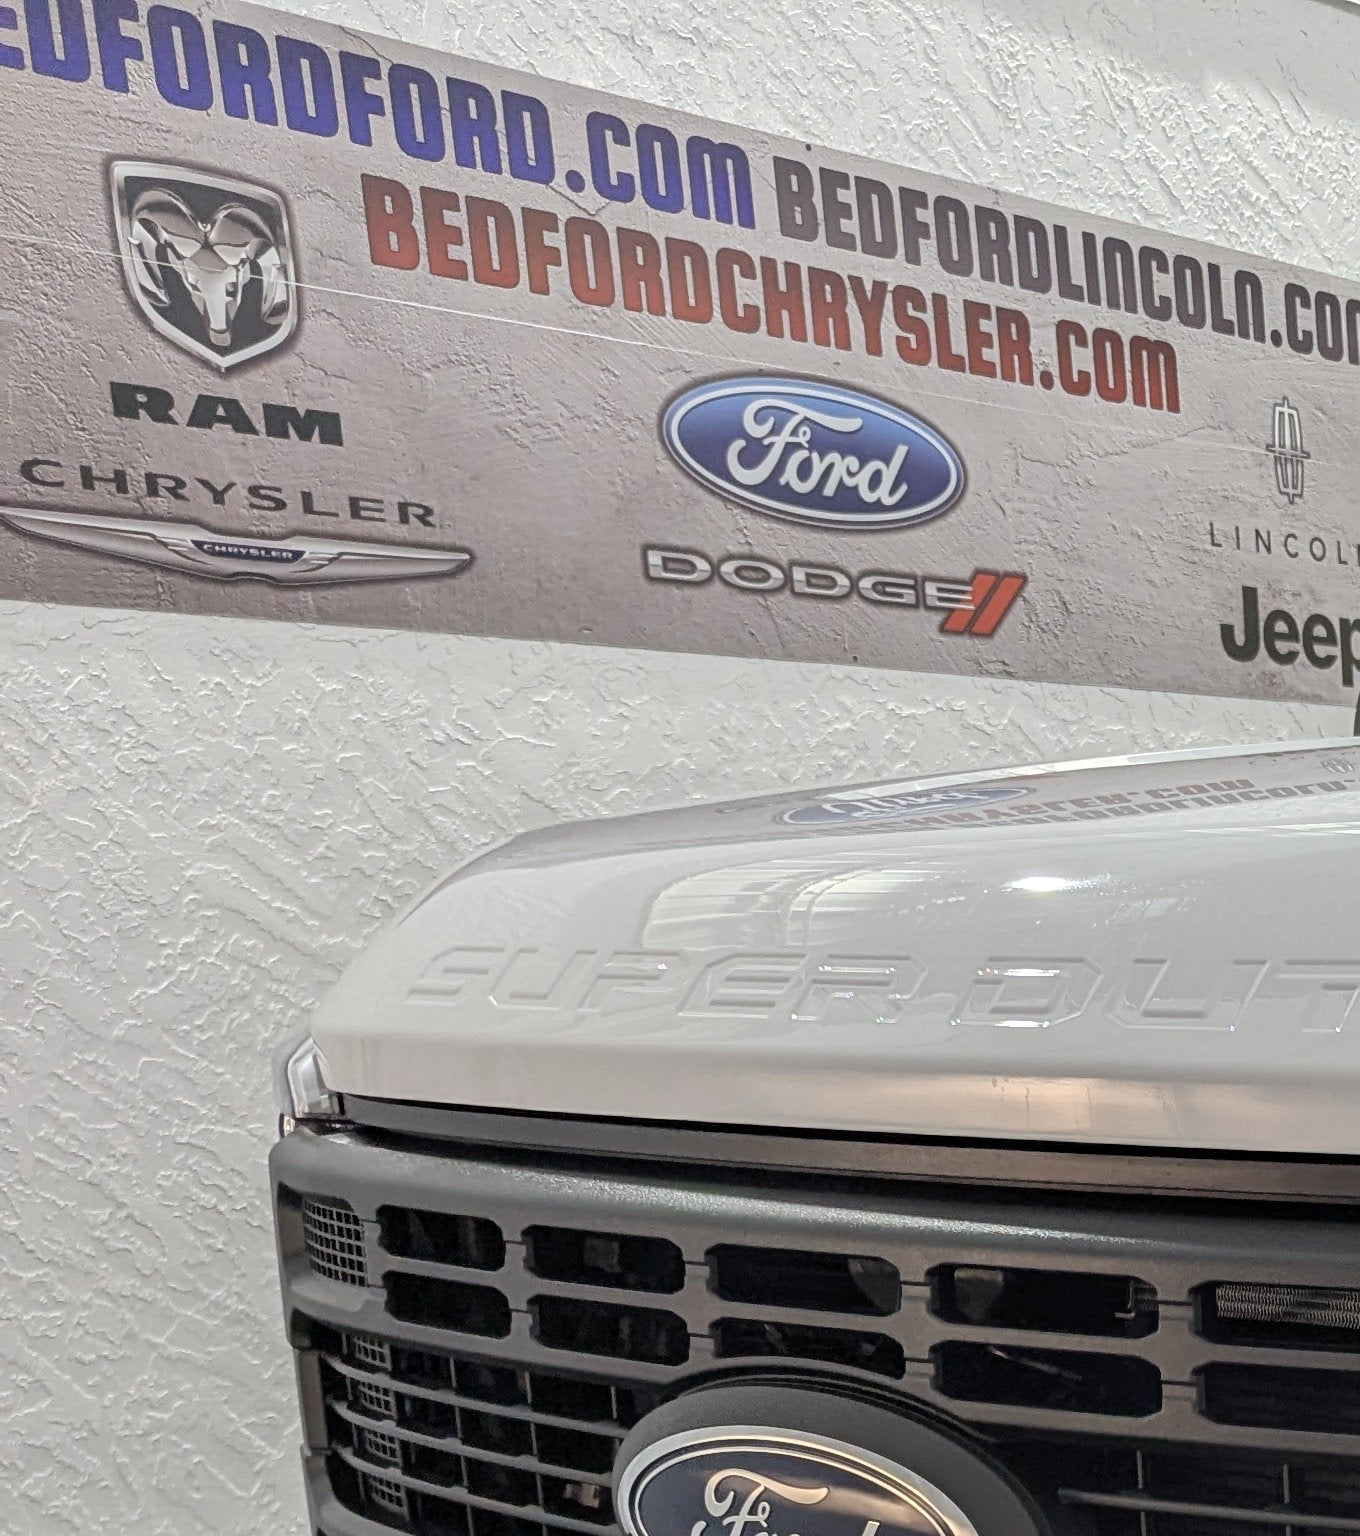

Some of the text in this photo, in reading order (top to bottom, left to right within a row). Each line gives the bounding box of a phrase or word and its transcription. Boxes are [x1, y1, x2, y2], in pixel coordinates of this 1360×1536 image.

[360, 173, 1181, 413] BEDFORDCHRYSLER.COM
[109, 381, 344, 446] RAM
[726, 399, 910, 507] Ford
[19, 459, 436, 529] CHRYSLER
[202, 543, 293, 560] CHRYSLER
[645, 548, 976, 610] DODGE
[406, 946, 930, 1024] SUPER
